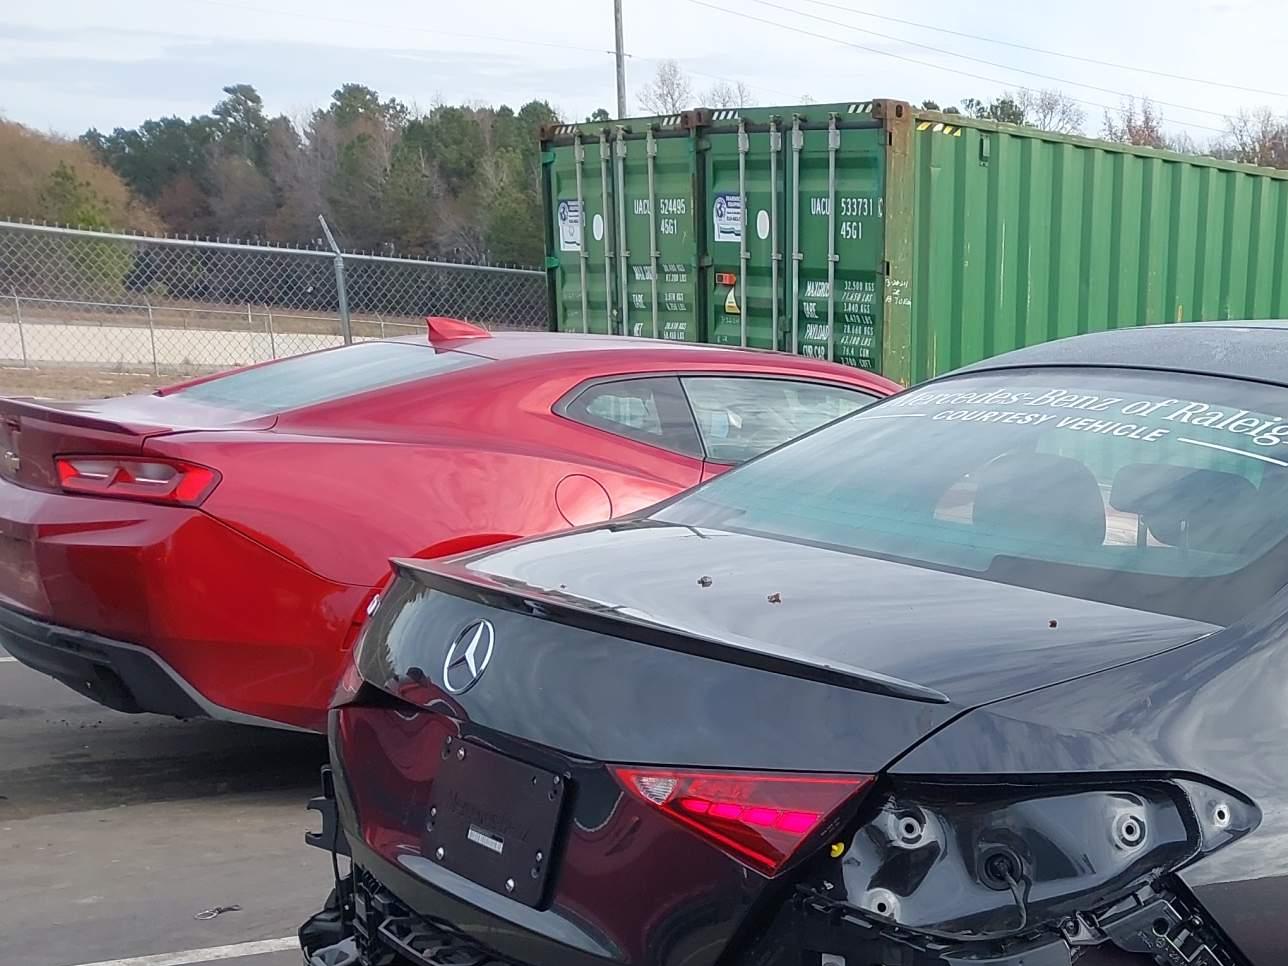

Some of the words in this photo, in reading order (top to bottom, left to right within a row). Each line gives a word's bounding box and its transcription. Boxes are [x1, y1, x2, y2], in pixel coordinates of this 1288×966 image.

[660, 198, 686, 214] 524495
[841, 198, 873, 216] 533731
[660, 218, 677, 235] 45G1
[840, 222, 862, 239] 45G1
[882, 388, 1124, 412] Mercedes-Benz
[1121, 399, 1178, 417] of
[932, 410, 1057, 426] COURTESY
[1055, 416, 1171, 442] VEHICLE
